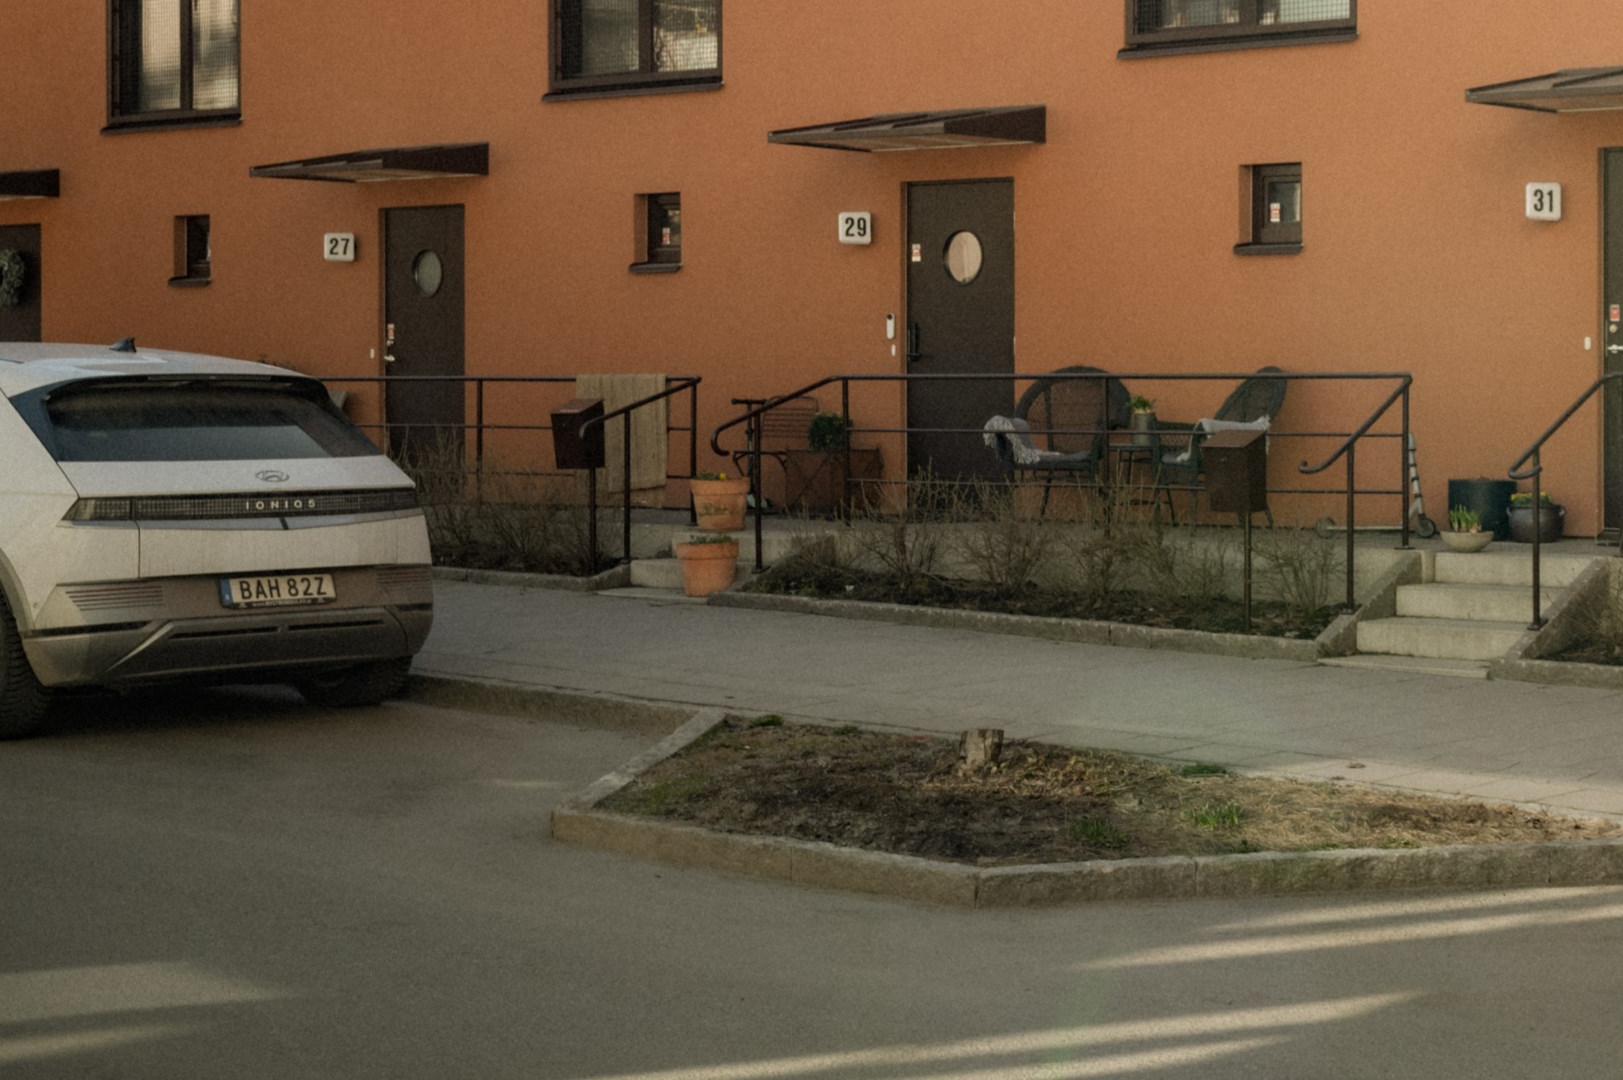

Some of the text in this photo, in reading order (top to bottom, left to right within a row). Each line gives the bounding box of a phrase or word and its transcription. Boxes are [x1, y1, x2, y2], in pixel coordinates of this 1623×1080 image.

[1534, 189, 1553, 212] 31
[845, 217, 867, 237] 29
[329, 237, 350, 255] 27
[245, 498, 316, 510] IONIQ 5
[240, 576, 327, 600] BAH 82Z
